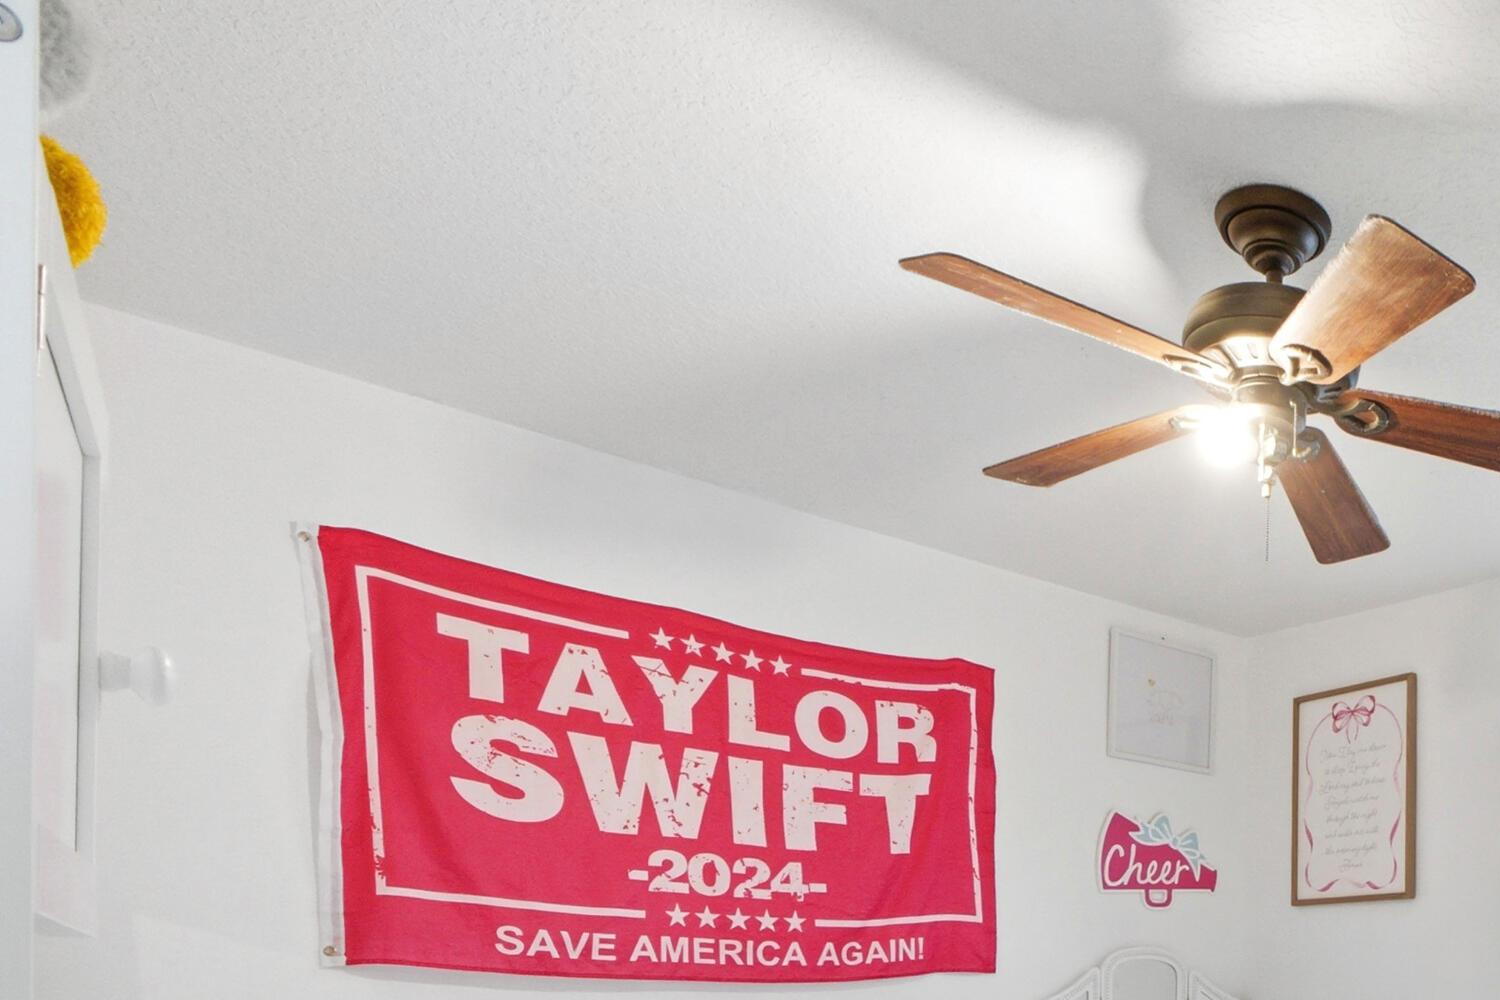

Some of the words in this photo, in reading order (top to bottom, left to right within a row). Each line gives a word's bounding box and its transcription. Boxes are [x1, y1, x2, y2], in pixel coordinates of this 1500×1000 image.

[436, 612, 937, 764] TAYLOR
[450, 714, 932, 855] SWIFT
[1103, 844, 1190, 887] Cheer
[495, 925, 617, 961] SAVE
[630, 935, 807, 966] AMERICA
[817, 937, 924, 966] AGAIN!
